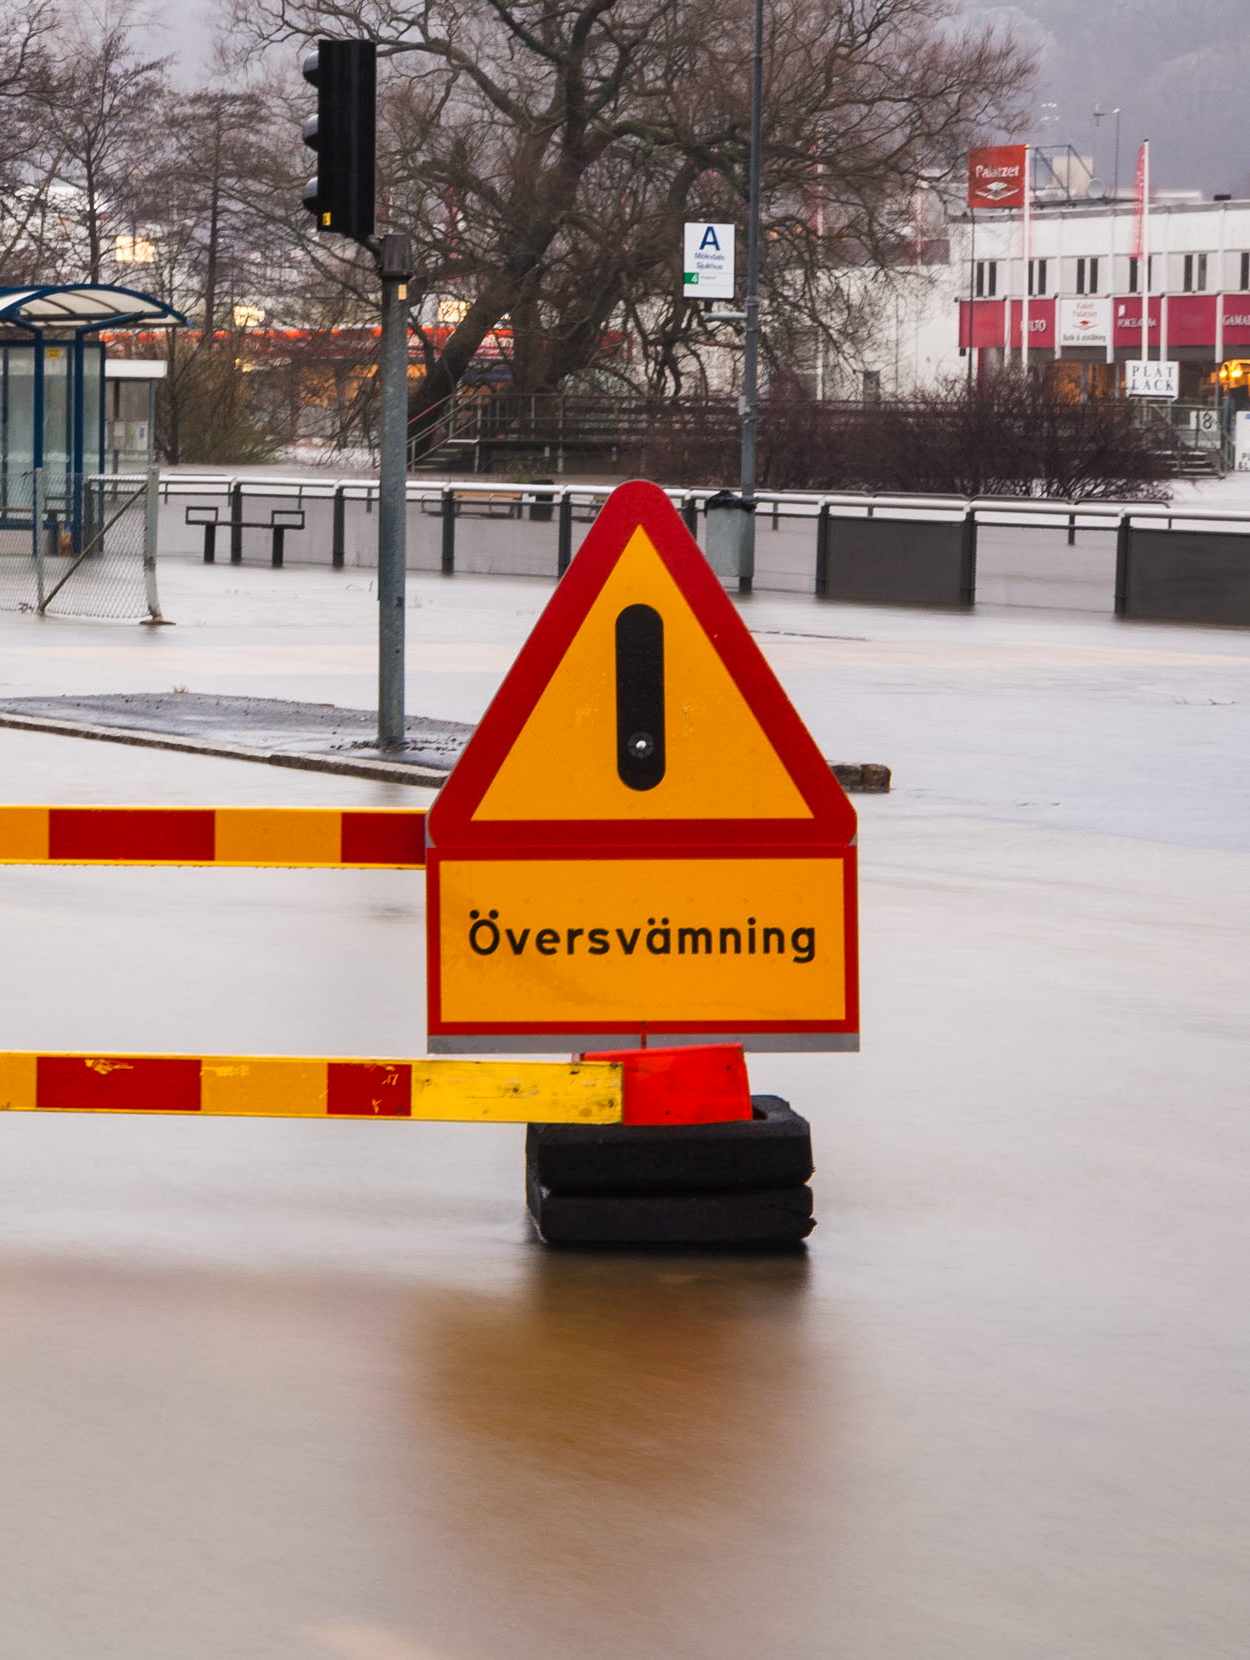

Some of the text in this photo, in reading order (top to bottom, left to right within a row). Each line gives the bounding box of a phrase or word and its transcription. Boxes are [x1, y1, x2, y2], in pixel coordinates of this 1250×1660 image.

[699, 226, 720, 251] A
[1132, 365, 1175, 378] PLAT
[1130, 379, 1174, 392] LACK
[469, 909, 816, 964] Översvämning
